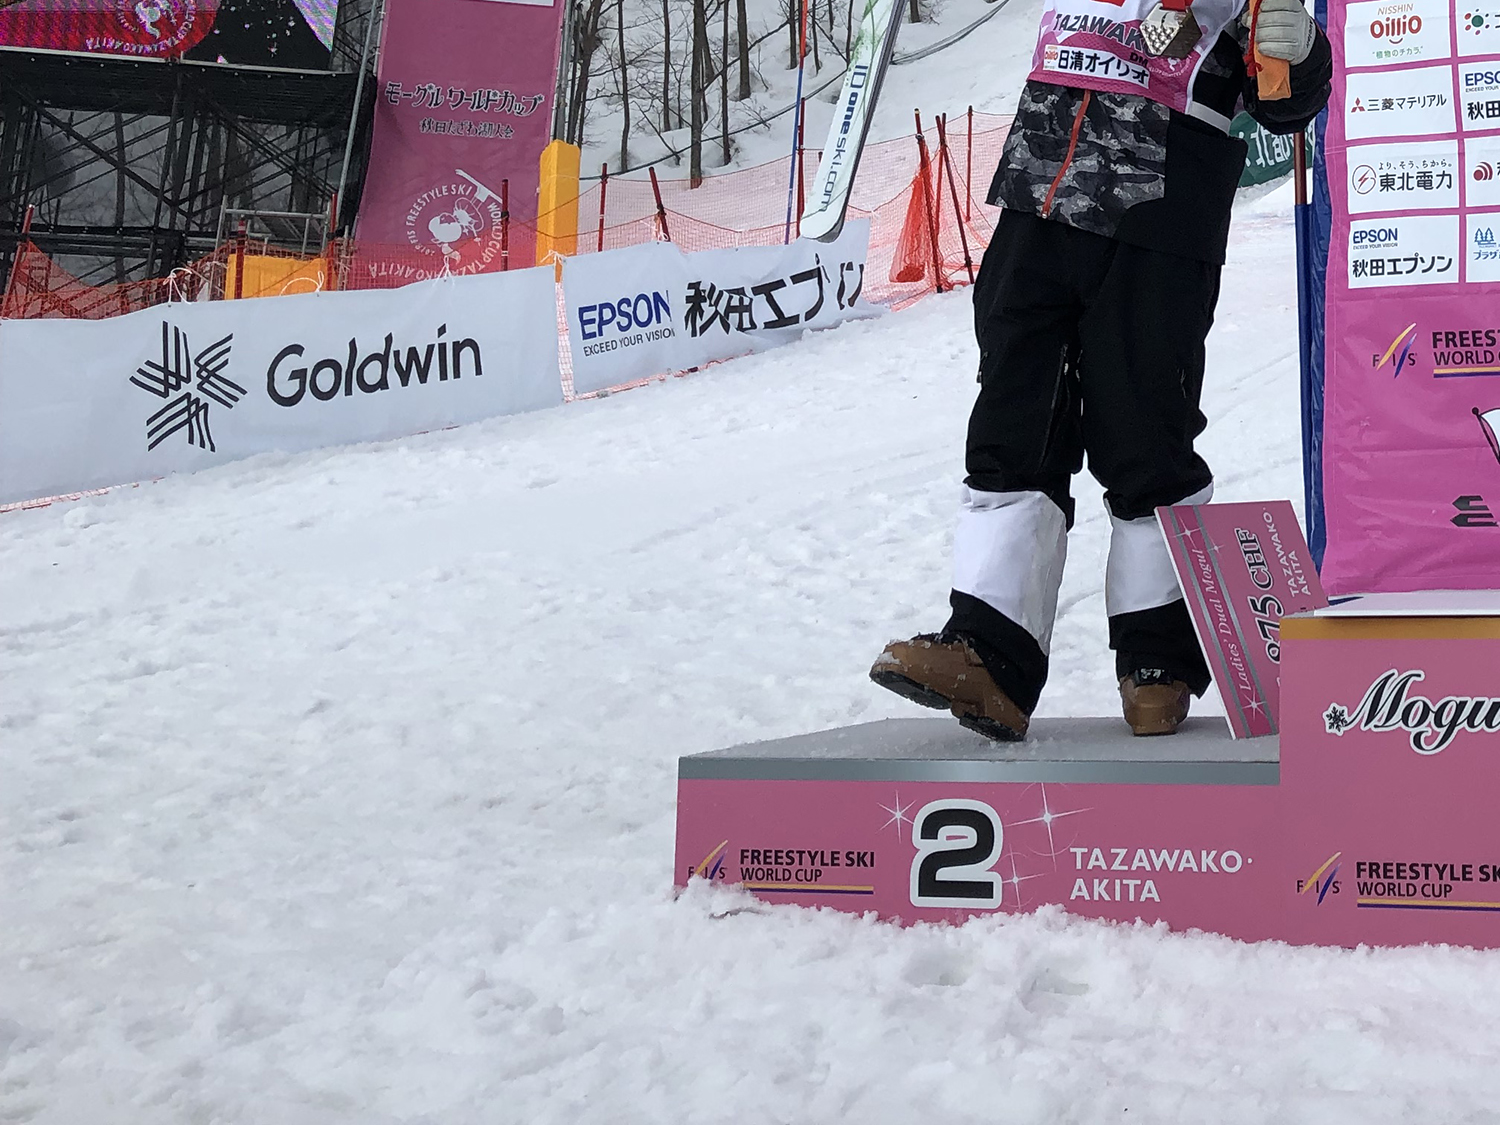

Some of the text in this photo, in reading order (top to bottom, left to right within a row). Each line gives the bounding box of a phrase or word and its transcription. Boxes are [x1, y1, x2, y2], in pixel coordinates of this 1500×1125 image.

[1377, 3, 1413, 16] NISSHIN
[1053, 13, 1156, 57] TAZAWAK
[1058, 49, 1149, 85] 日清オイリオ
[385, 81, 545, 116] モーグル ワールドカップ
[1367, 93, 1447, 112] 三菱マテリアル
[450, 184, 473, 196] SKI
[1379, 170, 1453, 193] 東北電力
[1353, 227, 1398, 244] EPSON
[1352, 253, 1453, 278] 秋田エプソン
[578, 289, 673, 340] EPSON
[583, 339, 618, 357] EXCEED
[619, 334, 643, 349] YOUR
[1433, 350, 1494, 366] WORLD
[266, 322, 483, 407] Goldwin
[1234, 527, 1275, 591] CHF
[1191, 549, 1220, 595] Mogul
[1288, 550, 1311, 596] AKITA
[1209, 598, 1233, 637] Dual
[740, 849, 875, 868] FREESTYLE SKI
[911, 798, 1003, 909] 2
[740, 867, 822, 882] WORLD CUP
[1355, 860, 1474, 881] FREESTYLE
[1069, 877, 1161, 902] AKITA
[1356, 880, 1453, 898] WORLD CUP
